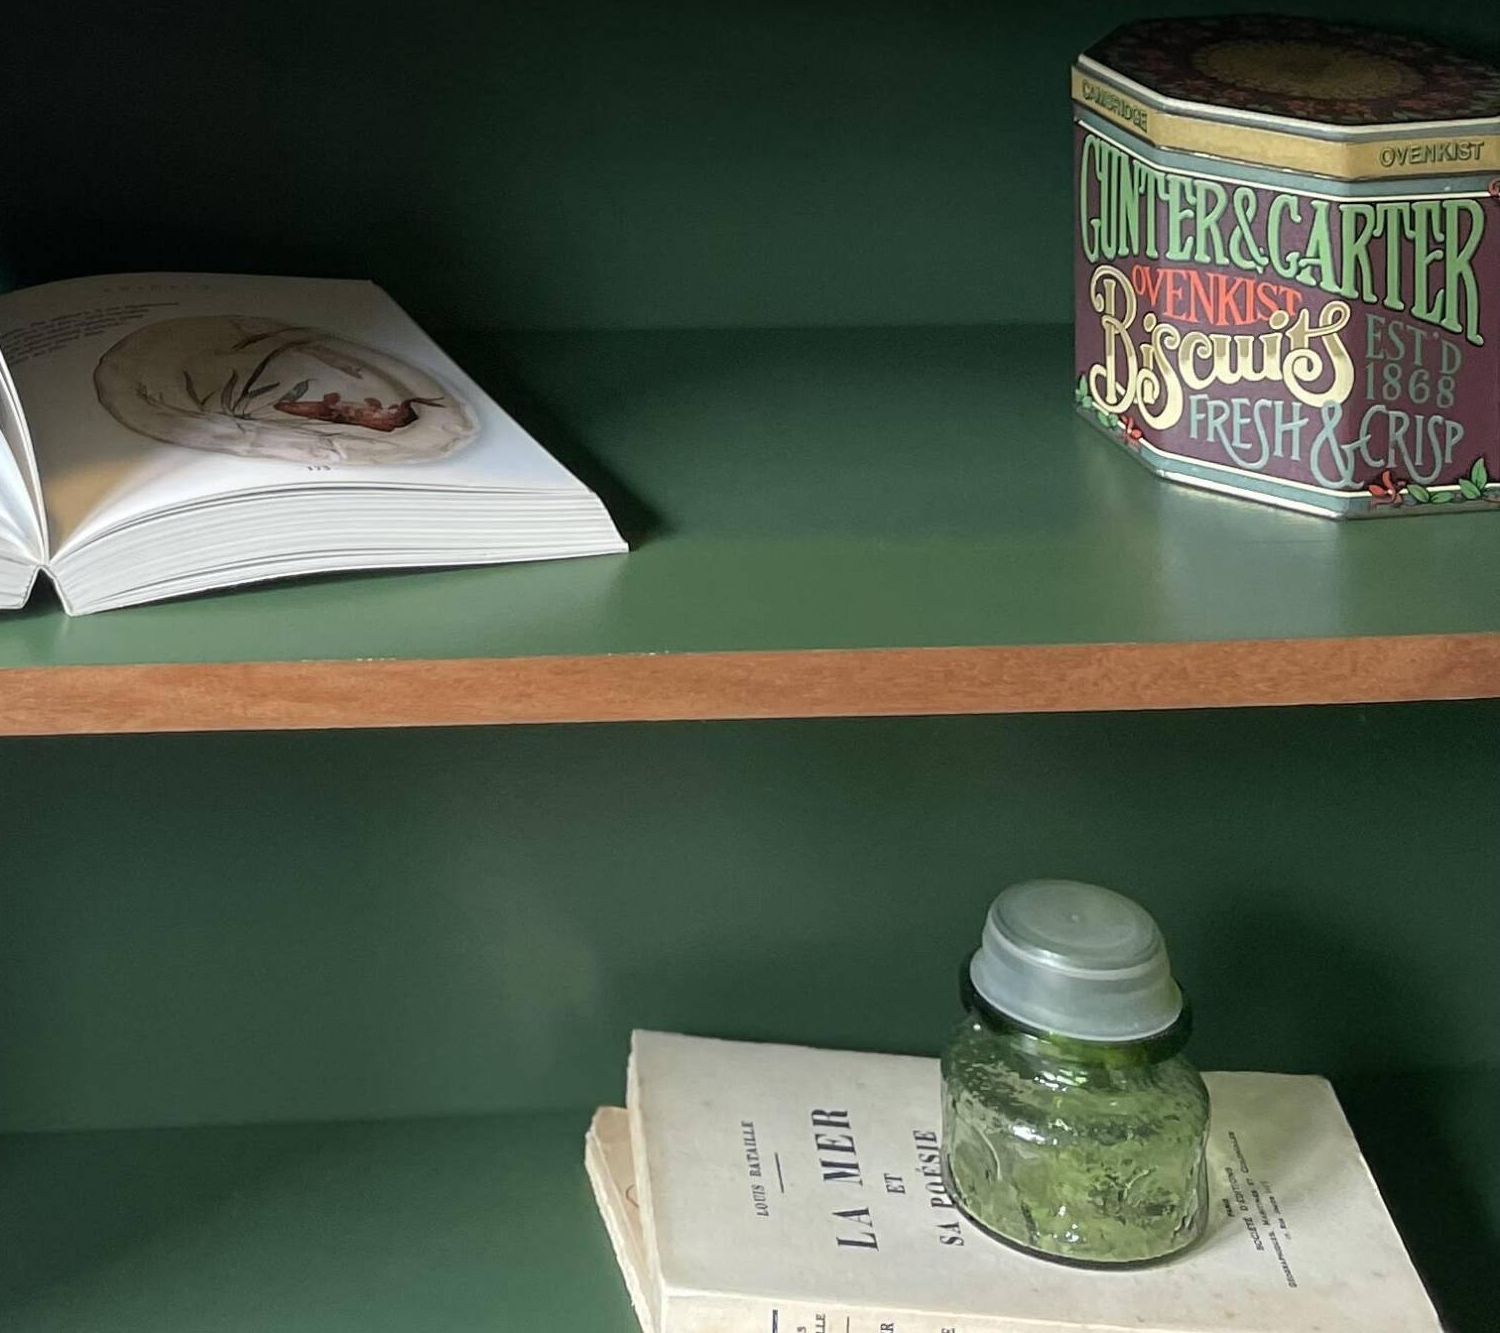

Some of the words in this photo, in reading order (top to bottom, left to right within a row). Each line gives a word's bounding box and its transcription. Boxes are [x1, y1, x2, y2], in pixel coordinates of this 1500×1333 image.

[1379, 140, 1485, 168] OVENKIST
[1131, 265, 1302, 327] OVENKIST
[1365, 362, 1457, 409] 1868
[1189, 394, 1308, 471] FRESH
[1359, 404, 1466, 484] CRISP
[741, 1121, 762, 1177] BATAILLE
[811, 1109, 863, 1186] MER
[913, 1130, 958, 1210] POÉSIE
[751, 1184, 769, 1217] LOUIS
[884, 1173, 906, 1194] ET
[832, 1206, 879, 1251] LA
[936, 1221, 965, 1247] SA
